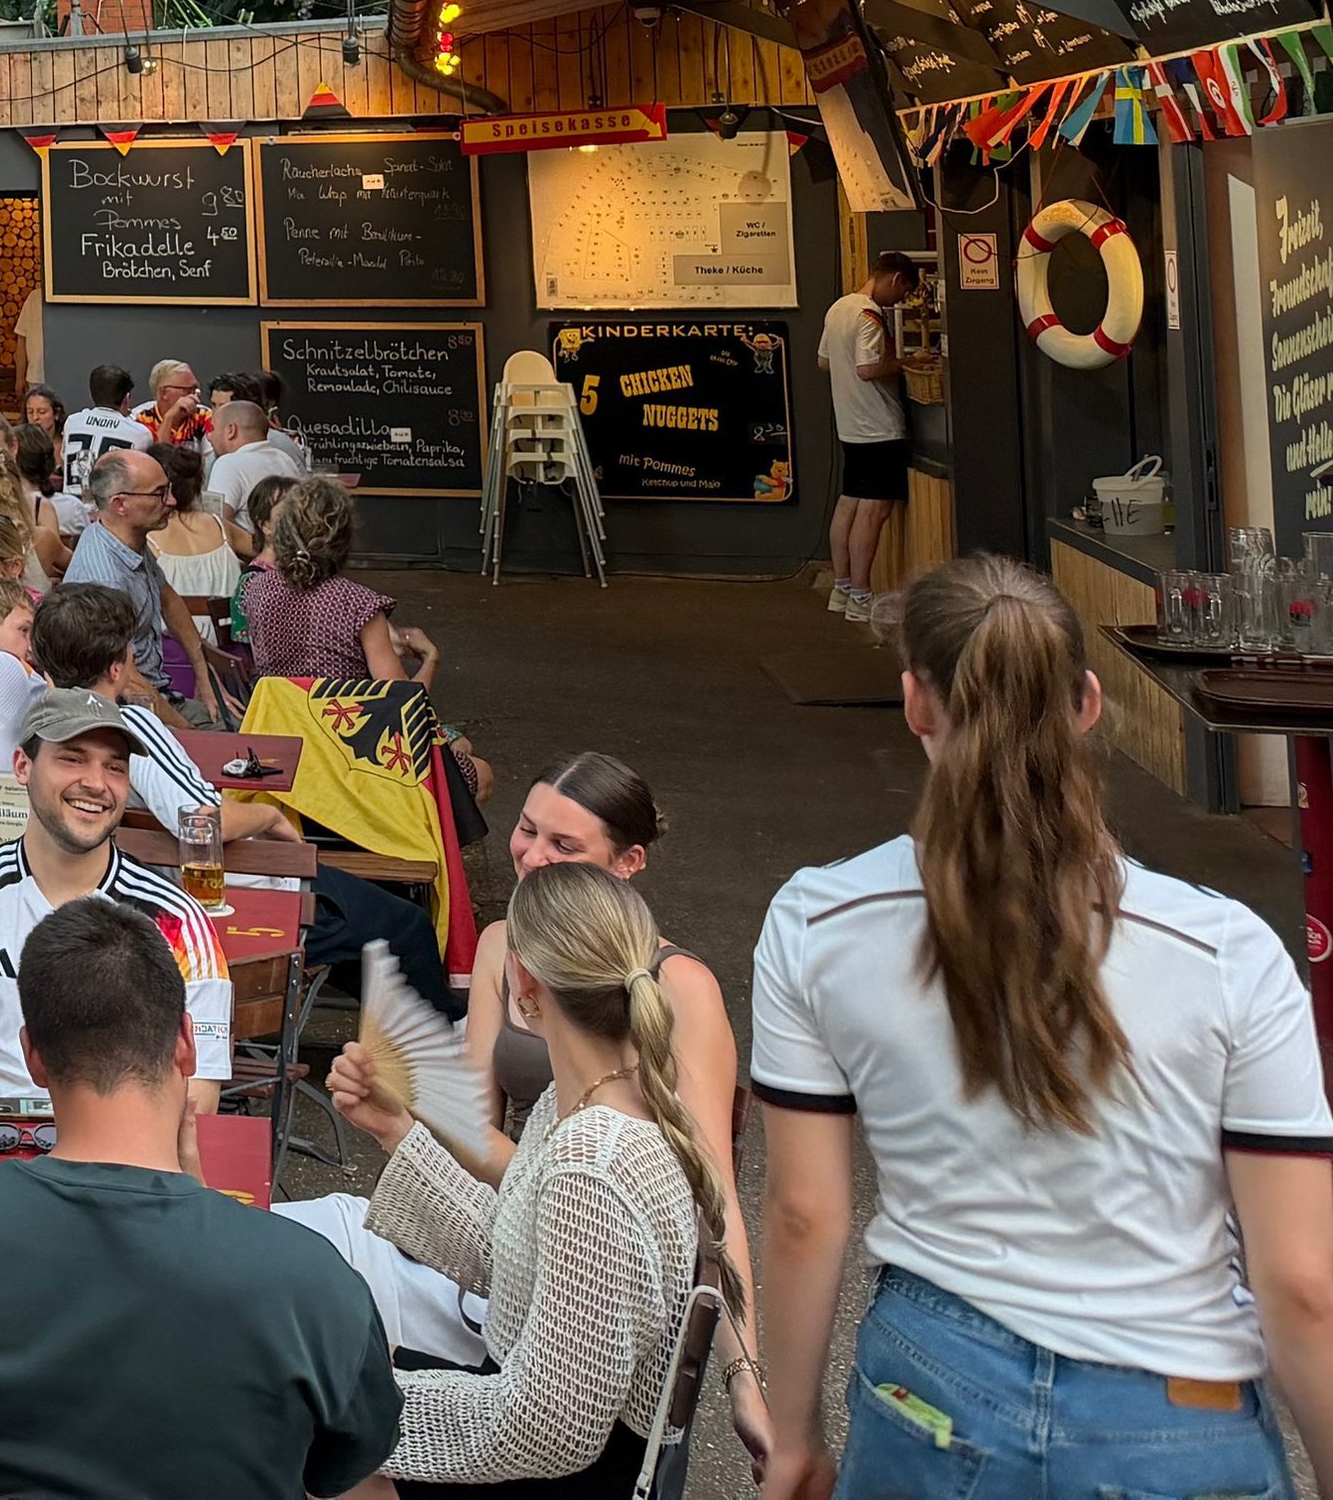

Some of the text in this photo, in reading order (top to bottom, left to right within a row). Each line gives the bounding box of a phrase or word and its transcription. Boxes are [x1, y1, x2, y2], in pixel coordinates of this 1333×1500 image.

[491, 112, 633, 139] Speisekasse
[68, 158, 195, 189] Bockwurst
[101, 190, 133, 206] mit
[318, 184, 348, 207] Wrap
[93, 209, 182, 231] Pommes
[283, 216, 320, 242] Penne
[329, 223, 349, 240] mit
[746, 221, 760, 229] WC
[1276, 194, 1323, 264] Freizeit,
[81, 232, 195, 257] Frikadelle
[735, 230, 776, 238] Zigaretten
[398, 249, 425, 267] Pesto
[694, 266, 724, 275] Theke
[732, 264, 764, 275] Küche
[102, 259, 212, 281] Brötchen, Senf
[583, 324, 754, 338] KINDERKARTE:
[1271, 306, 1333, 372] Sonnenschei
[283, 338, 449, 361] Schnitzelbrötchen
[306, 363, 436, 380] Krautsalat, Tomate,
[619, 364, 694, 398] CHICKEN
[307, 379, 453, 395] Remoulade, Chilisauce
[580, 374, 600, 415] 5
[1273, 383, 1291, 423] Die
[1292, 372, 1326, 424] Gläser
[85, 415, 120, 429] UNDAV
[287, 415, 391, 441] Quesadilla
[642, 403, 719, 431] NUGGETS
[307, 437, 465, 455] Frühlingszwiebeln, Paprika,
[1286, 429, 1307, 472] und
[382, 454, 465, 468] Tomatensalsa
[619, 452, 697, 477] mit Pommes
[642, 477, 679, 489] Ketchup
[680, 478, 697, 488] und
[1305, 479, 1332, 520] rein!
